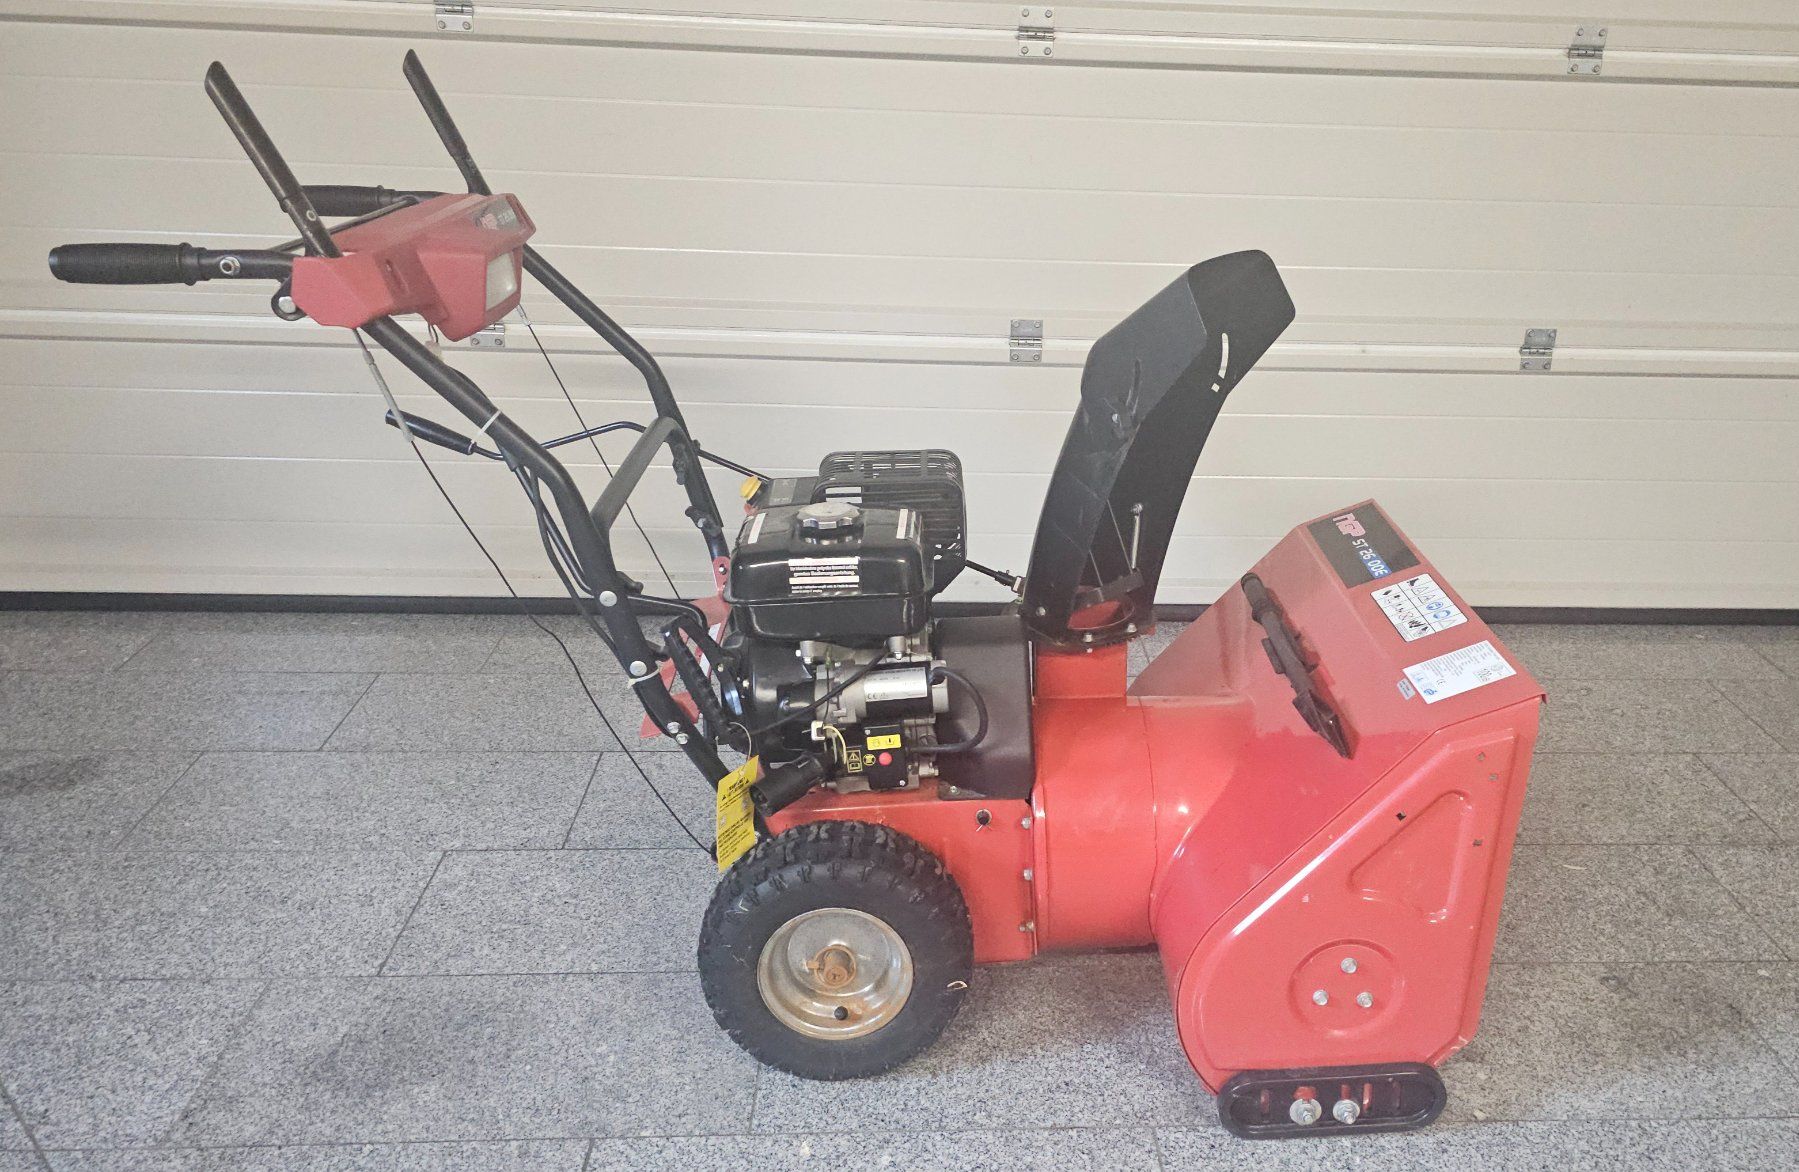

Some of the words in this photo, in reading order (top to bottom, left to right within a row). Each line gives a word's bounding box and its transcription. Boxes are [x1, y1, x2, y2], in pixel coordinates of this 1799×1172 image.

[1352, 538, 1368, 549] ST
[1360, 548, 1376, 560] 26
[1368, 560, 1388, 577] 00E
